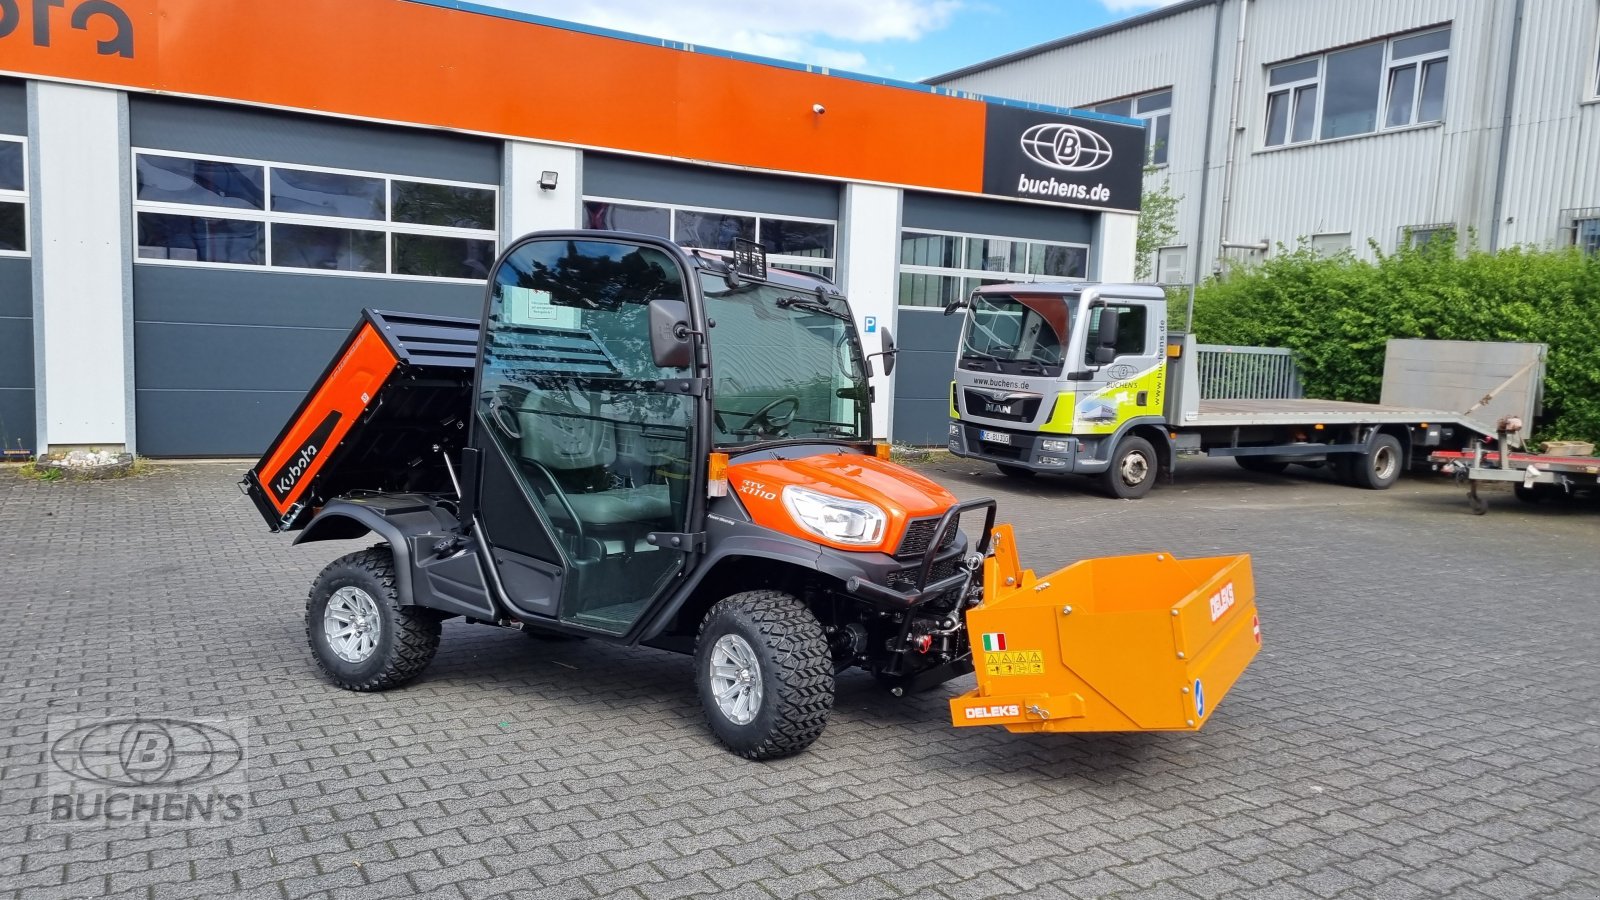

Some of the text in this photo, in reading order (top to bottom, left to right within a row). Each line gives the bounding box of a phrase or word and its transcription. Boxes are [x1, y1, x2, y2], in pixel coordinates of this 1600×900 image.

[1018, 173, 1110, 201] buchens.de
[865, 317, 875, 331] P
[1154, 319, 1165, 406] www.buchens.de
[973, 377, 1030, 390] www.buchens.de
[1106, 381, 1138, 389] BUCHEN'S
[985, 402, 1012, 414] MAN
[276, 444, 318, 494] Kubota
[742, 479, 765, 489] RTV
[740, 485, 777, 500] X1110
[1209, 581, 1235, 623] DELEKS
[965, 704, 1020, 719] DELEKS
